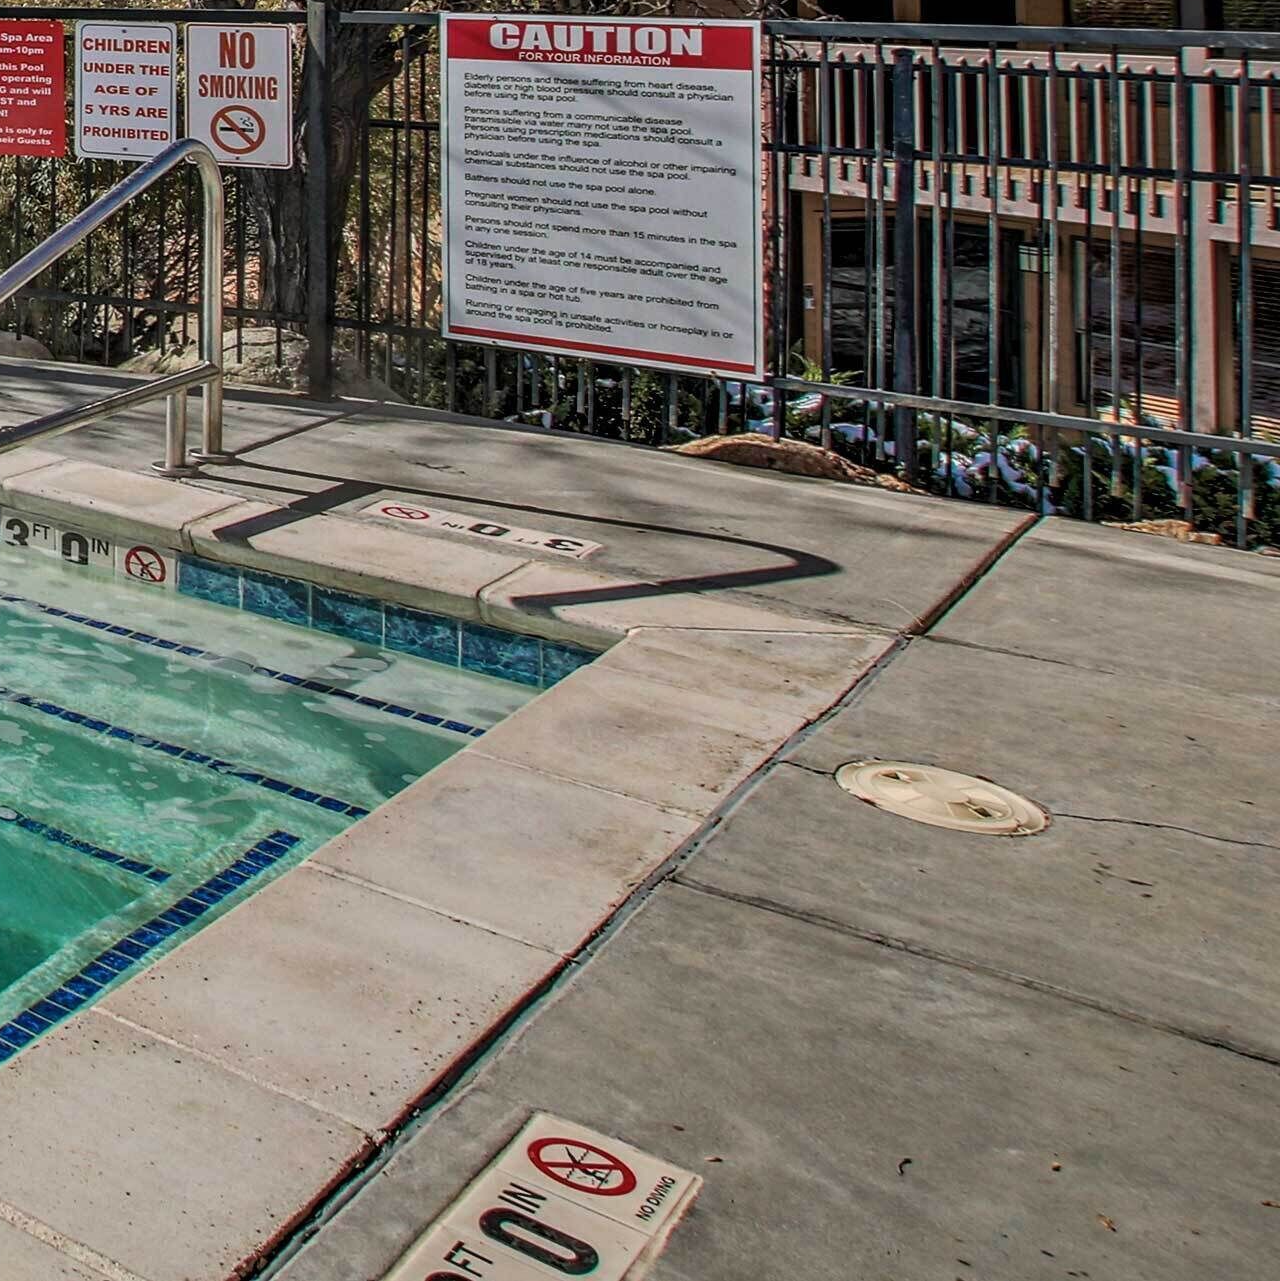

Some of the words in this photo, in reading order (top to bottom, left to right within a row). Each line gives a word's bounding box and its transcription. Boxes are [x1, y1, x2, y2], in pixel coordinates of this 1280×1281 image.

[0, 32, 22, 43] Spa
[26, 33, 53, 41] Area
[490, 23, 703, 56] CAUTION
[83, 38, 170, 54] CHILDREN
[220, 32, 256, 70] NO
[20, 63, 44, 71] Pool
[518, 52, 543, 61] FOR
[547, 53, 581, 63] YOUR
[584, 54, 670, 66] INFORMATION
[84, 63, 136, 75] UNDER
[140, 65, 170, 77] THE
[1, 74, 52, 84] operating
[464, 73, 494, 83] Elderly
[496, 76, 532, 85] persons
[534, 76, 551, 84] and
[553, 77, 579, 85] those
[581, 78, 622, 89] suffering
[623, 80, 646, 88] from
[648, 81, 673, 89] heart
[676, 82, 717, 91] disease,
[10, 86, 29, 94] and
[94, 85, 130, 95] AGE
[135, 87, 159, 97] OF
[199, 74, 278, 101] SMOKING
[464, 82, 501, 90] diabetes
[514, 84, 534, 93] high
[536, 85, 562, 93] blood
[563, 88, 604, 97] pressure
[607, 88, 638, 96] should
[640, 90, 675, 98] consult
[686, 92, 734, 103] physician
[464, 90, 492, 98] before
[493, 91, 518, 101] using
[537, 95, 554, 103] spa
[555, 94, 578, 104] pool.
[85, 105, 94, 115] 5
[99, 105, 131, 117] YRS
[135, 108, 168, 119] ARE
[464, 107, 500, 115] Persons
[502, 109, 541, 120] suffering
[542, 111, 564, 119] from
[574, 113, 643, 123] communicable
[644, 117, 683, 126] disease
[16, 126, 37, 136] only
[39, 127, 53, 135] for
[83, 126, 170, 141] PROHIBITED
[17, 136, 51, 145] Guests
[464, 174, 499, 183] Bathers
[500, 177, 531, 185] should
[532, 179, 547, 187] not
[568, 182, 583, 190] the
[585, 185, 603, 193] spa
[605, 185, 626, 195] pool
[628, 187, 656, 196] alone.
[464, 199, 509, 211] consulting
[511, 203, 531, 211] their
[533, 205, 583, 218] physicians.
[465, 216, 501, 225] Persons
[503, 219, 533, 229] should
[534, 222, 550, 230] not
[551, 224, 580, 235] spend
[582, 228, 607, 236] more
[608, 229, 630, 238] than
[634, 231, 645, 239] 15
[647, 233, 686, 243] minutes
[699, 238, 716, 246] the
[718, 241, 737, 250] spa
[474, 227, 491, 235] any
[512, 229, 549, 239] session.
[465, 299, 502, 312] Running
[515, 306, 558, 319] engaging
[559, 311, 568, 319] in
[570, 312, 602, 323] unsafe
[604, 316, 645, 328] activities
[660, 323, 708, 339] horseplay
[710, 330, 720, 338] in
[468, 524, 511, 537] 0
[5, 519, 30, 547] 3
[33, 523, 50, 541] FT
[62, 532, 89, 566] 0
[92, 538, 110, 556] IN
[544, 539, 584, 552] 3
[498, 1182, 548, 1215] IN
[636, 1205, 656, 1222] NO
[649, 1175, 676, 1208] DIVING
[479, 1207, 600, 1276] 0
[444, 1241, 494, 1278] FT
